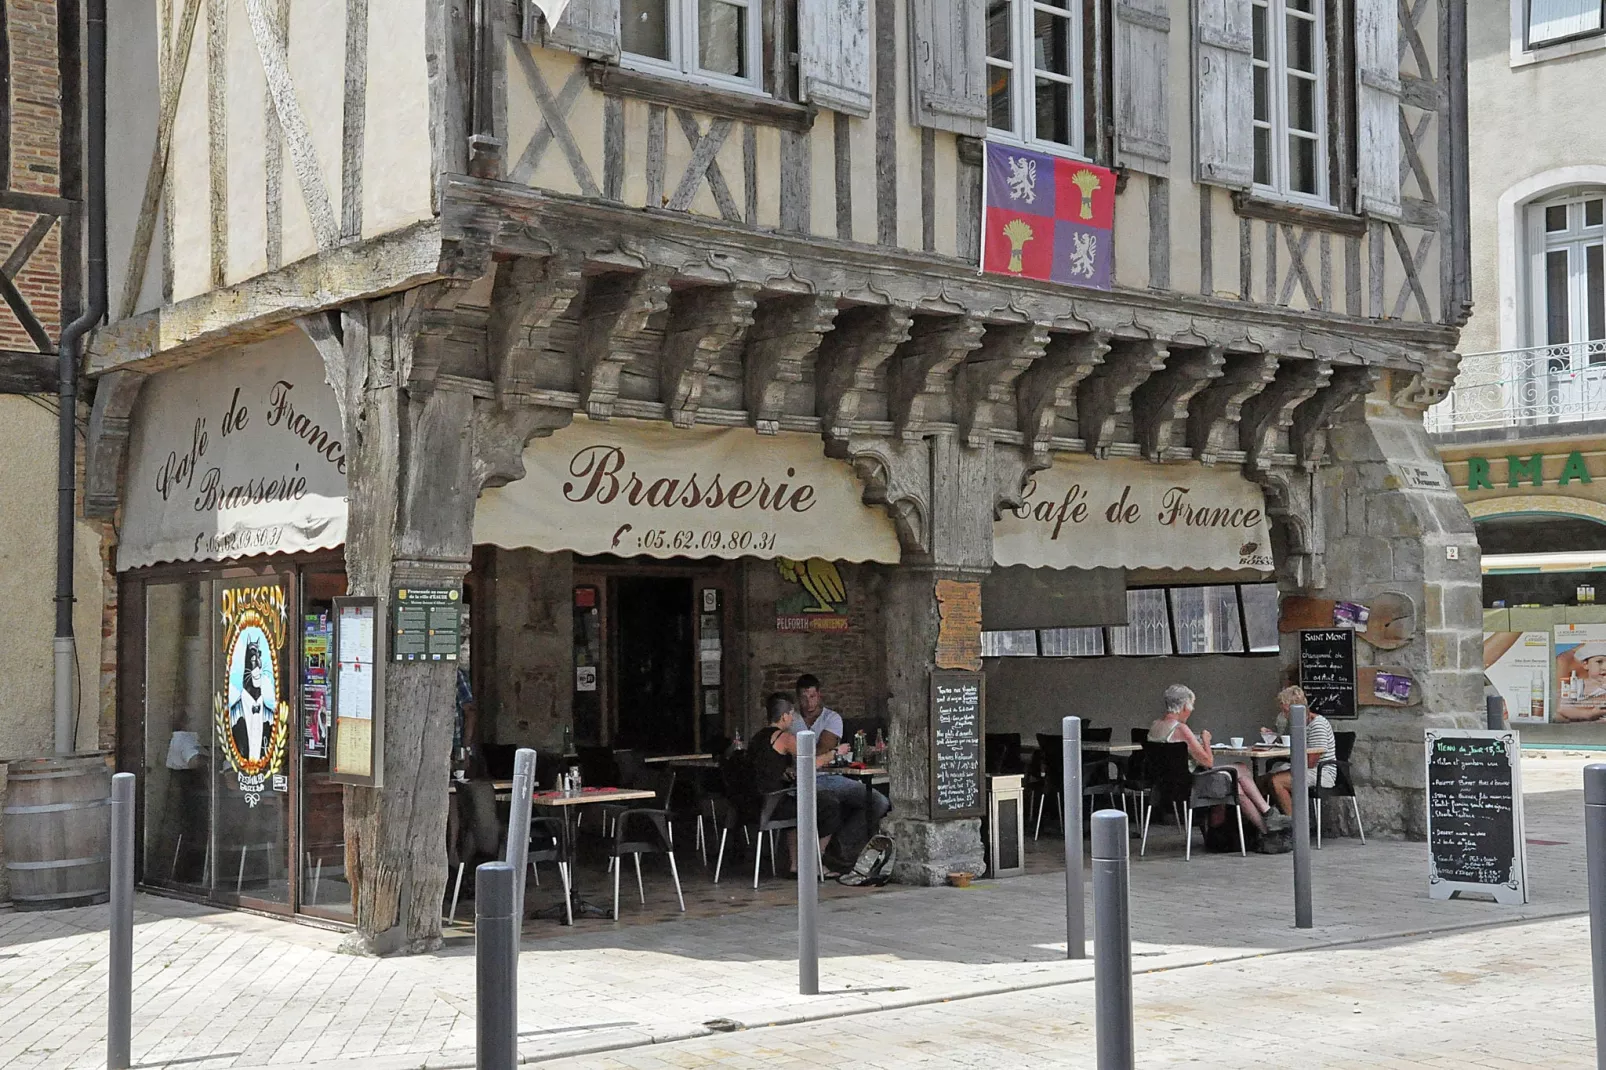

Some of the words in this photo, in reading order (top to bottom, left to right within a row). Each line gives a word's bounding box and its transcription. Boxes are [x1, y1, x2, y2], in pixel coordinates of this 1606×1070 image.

[157, 418, 209, 501] Café
[222, 387, 249, 437] de
[267, 380, 346, 475] France
[194, 463, 308, 512] Brasserie
[563, 444, 817, 513] Brasserie
[1011, 479, 1089, 540] Café
[1105, 486, 1141, 524] de
[1158, 486, 1262, 528] France
[1449, 548, 1456, 558] 2
[776, 617, 809, 629] PELFORTH
